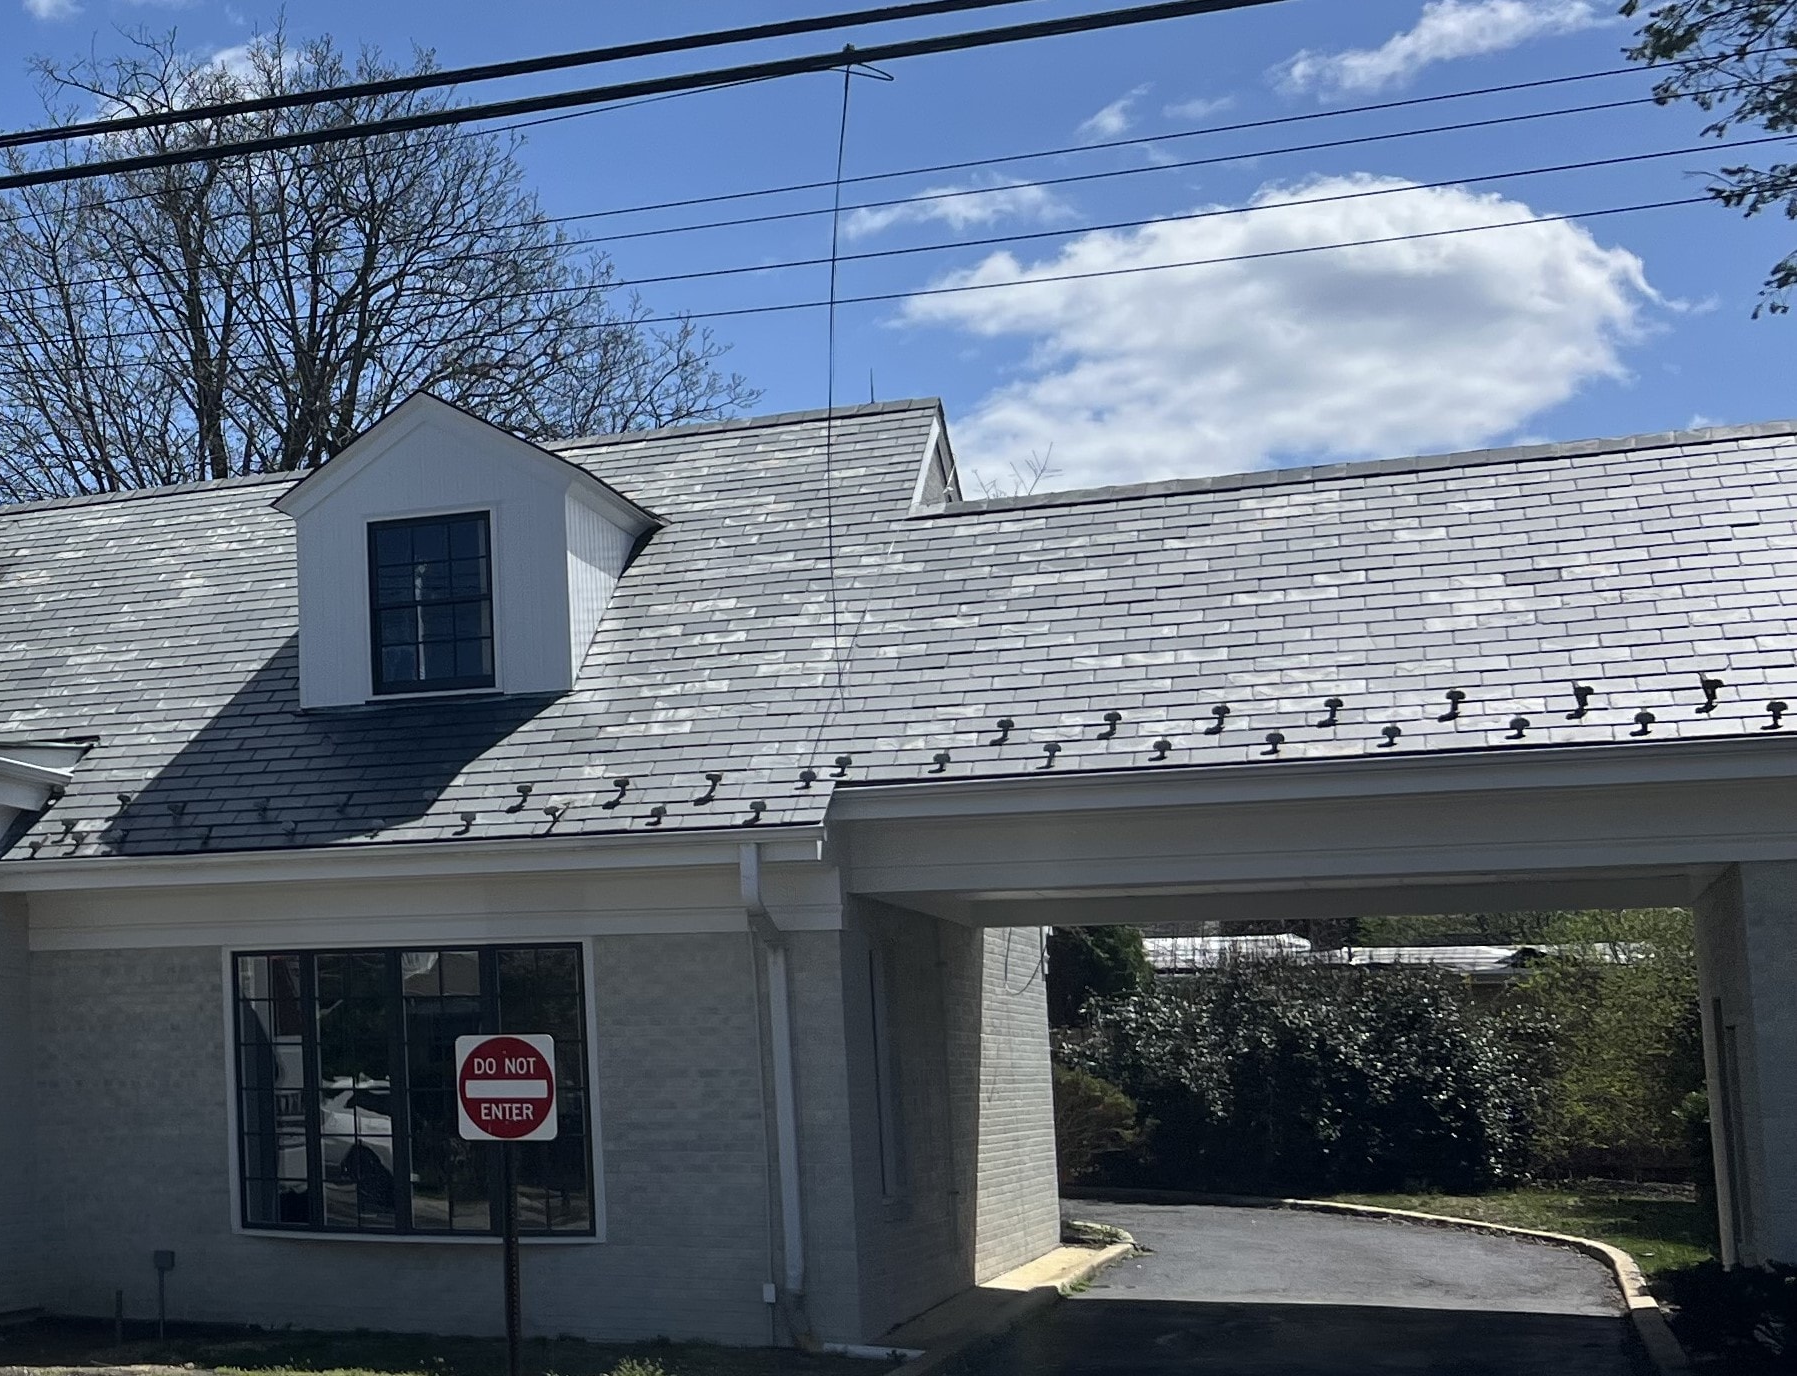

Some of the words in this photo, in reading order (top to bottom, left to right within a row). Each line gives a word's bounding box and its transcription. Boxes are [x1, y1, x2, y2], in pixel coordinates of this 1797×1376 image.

[473, 1058, 497, 1075] DO
[504, 1058, 537, 1075] NOT
[480, 1103, 534, 1121] ENTER
